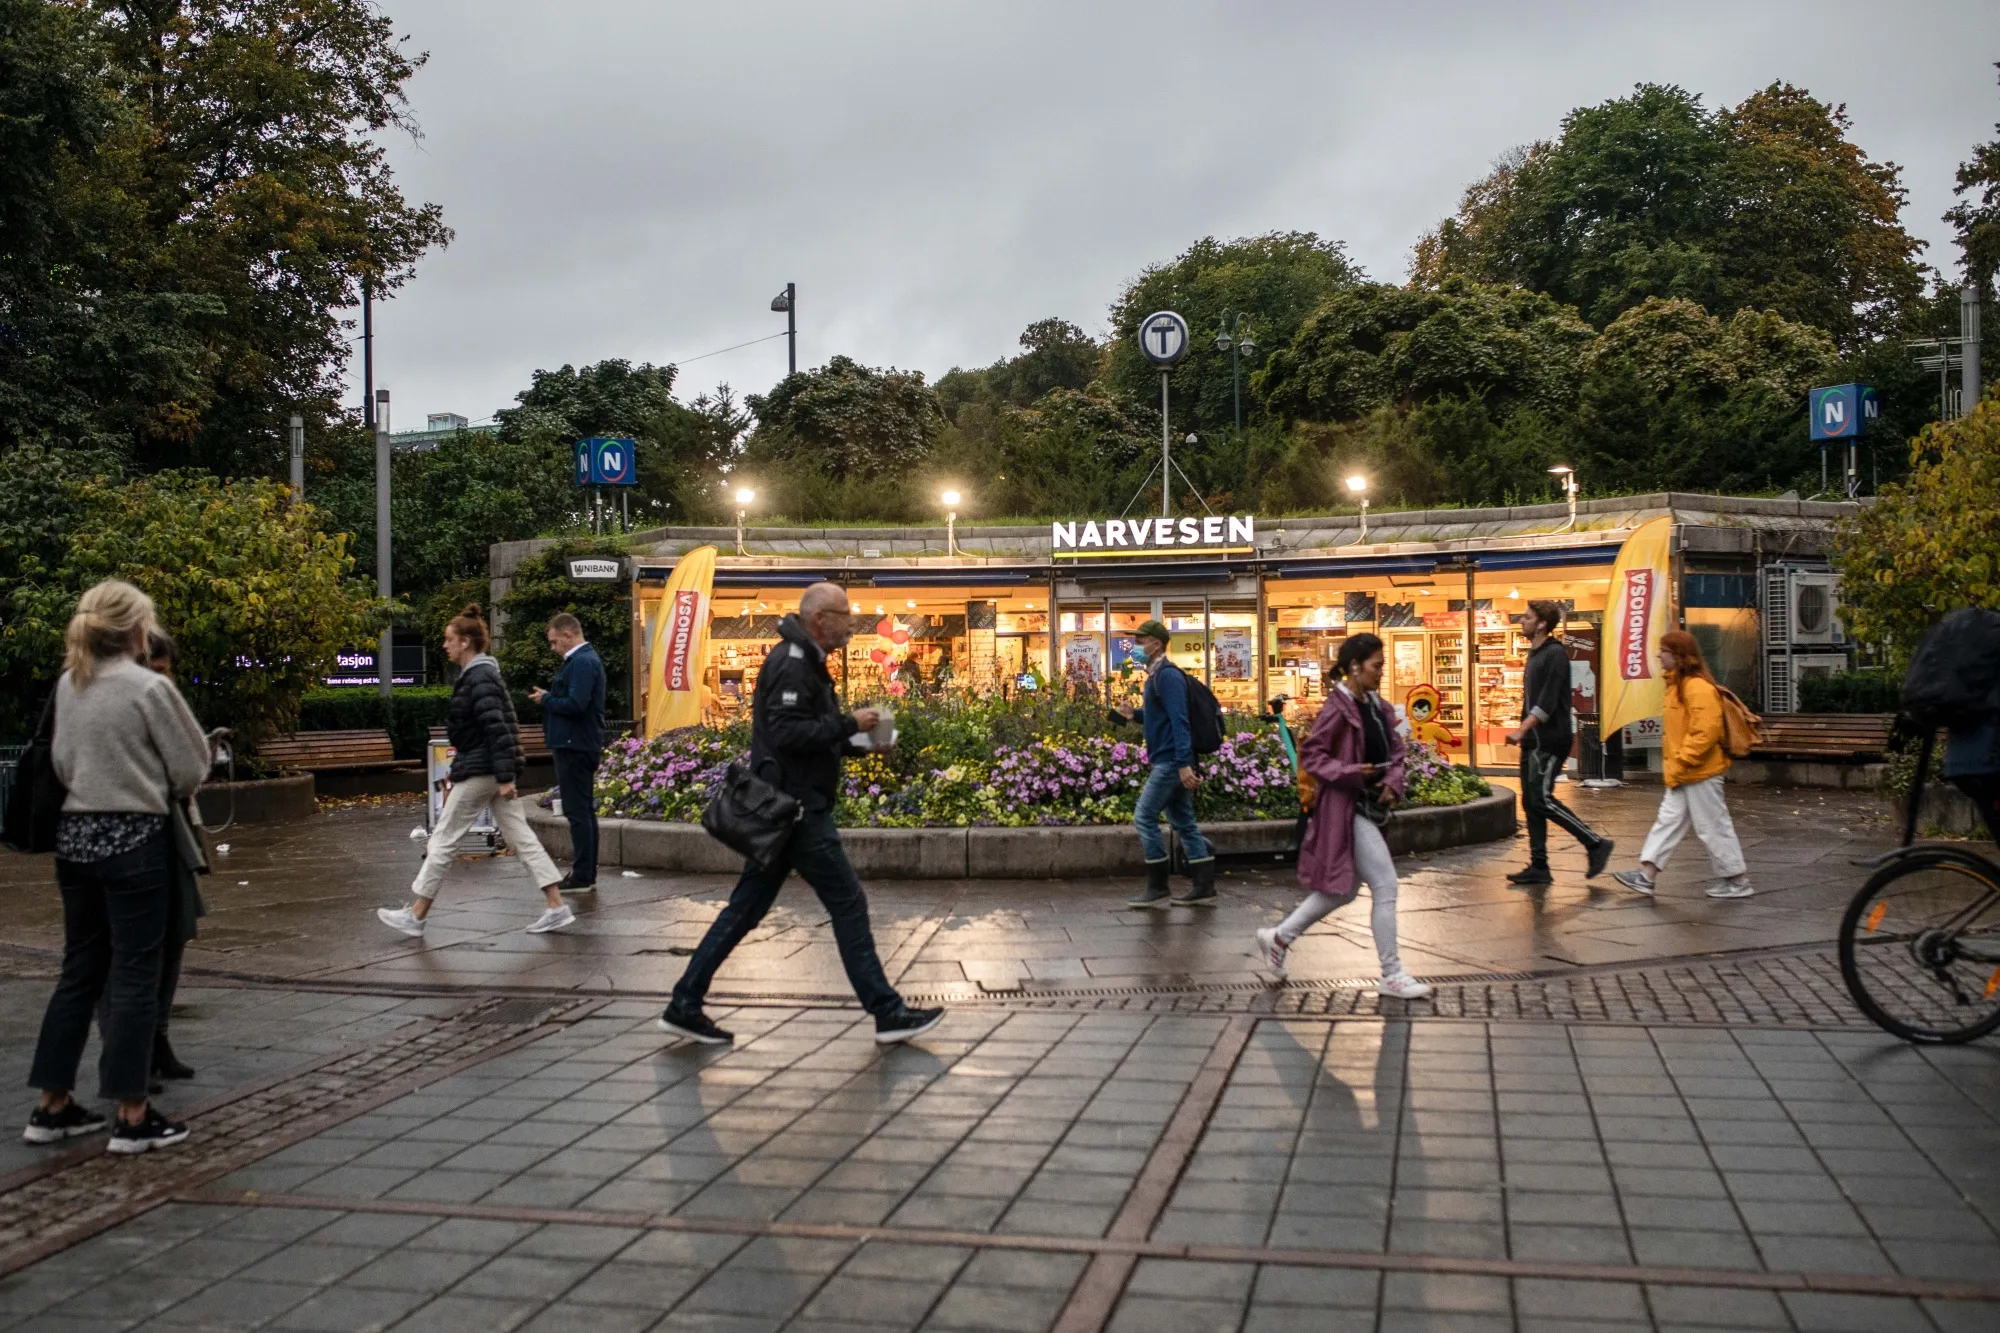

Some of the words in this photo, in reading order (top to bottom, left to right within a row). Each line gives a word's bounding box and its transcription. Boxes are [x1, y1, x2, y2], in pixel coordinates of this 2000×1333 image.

[1151, 326, 1175, 354] T
[1825, 401, 1843, 424] N
[1865, 400, 1878, 418] N
[580, 454, 588, 473] N
[604, 452, 620, 471] N
[1053, 516, 1254, 548] NARVESEN
[574, 564, 616, 573] MINIBANK
[1627, 572, 1648, 677] GRANDIOSA
[671, 594, 693, 689] GRANDIOSA
[337, 653, 373, 668] tasjon
